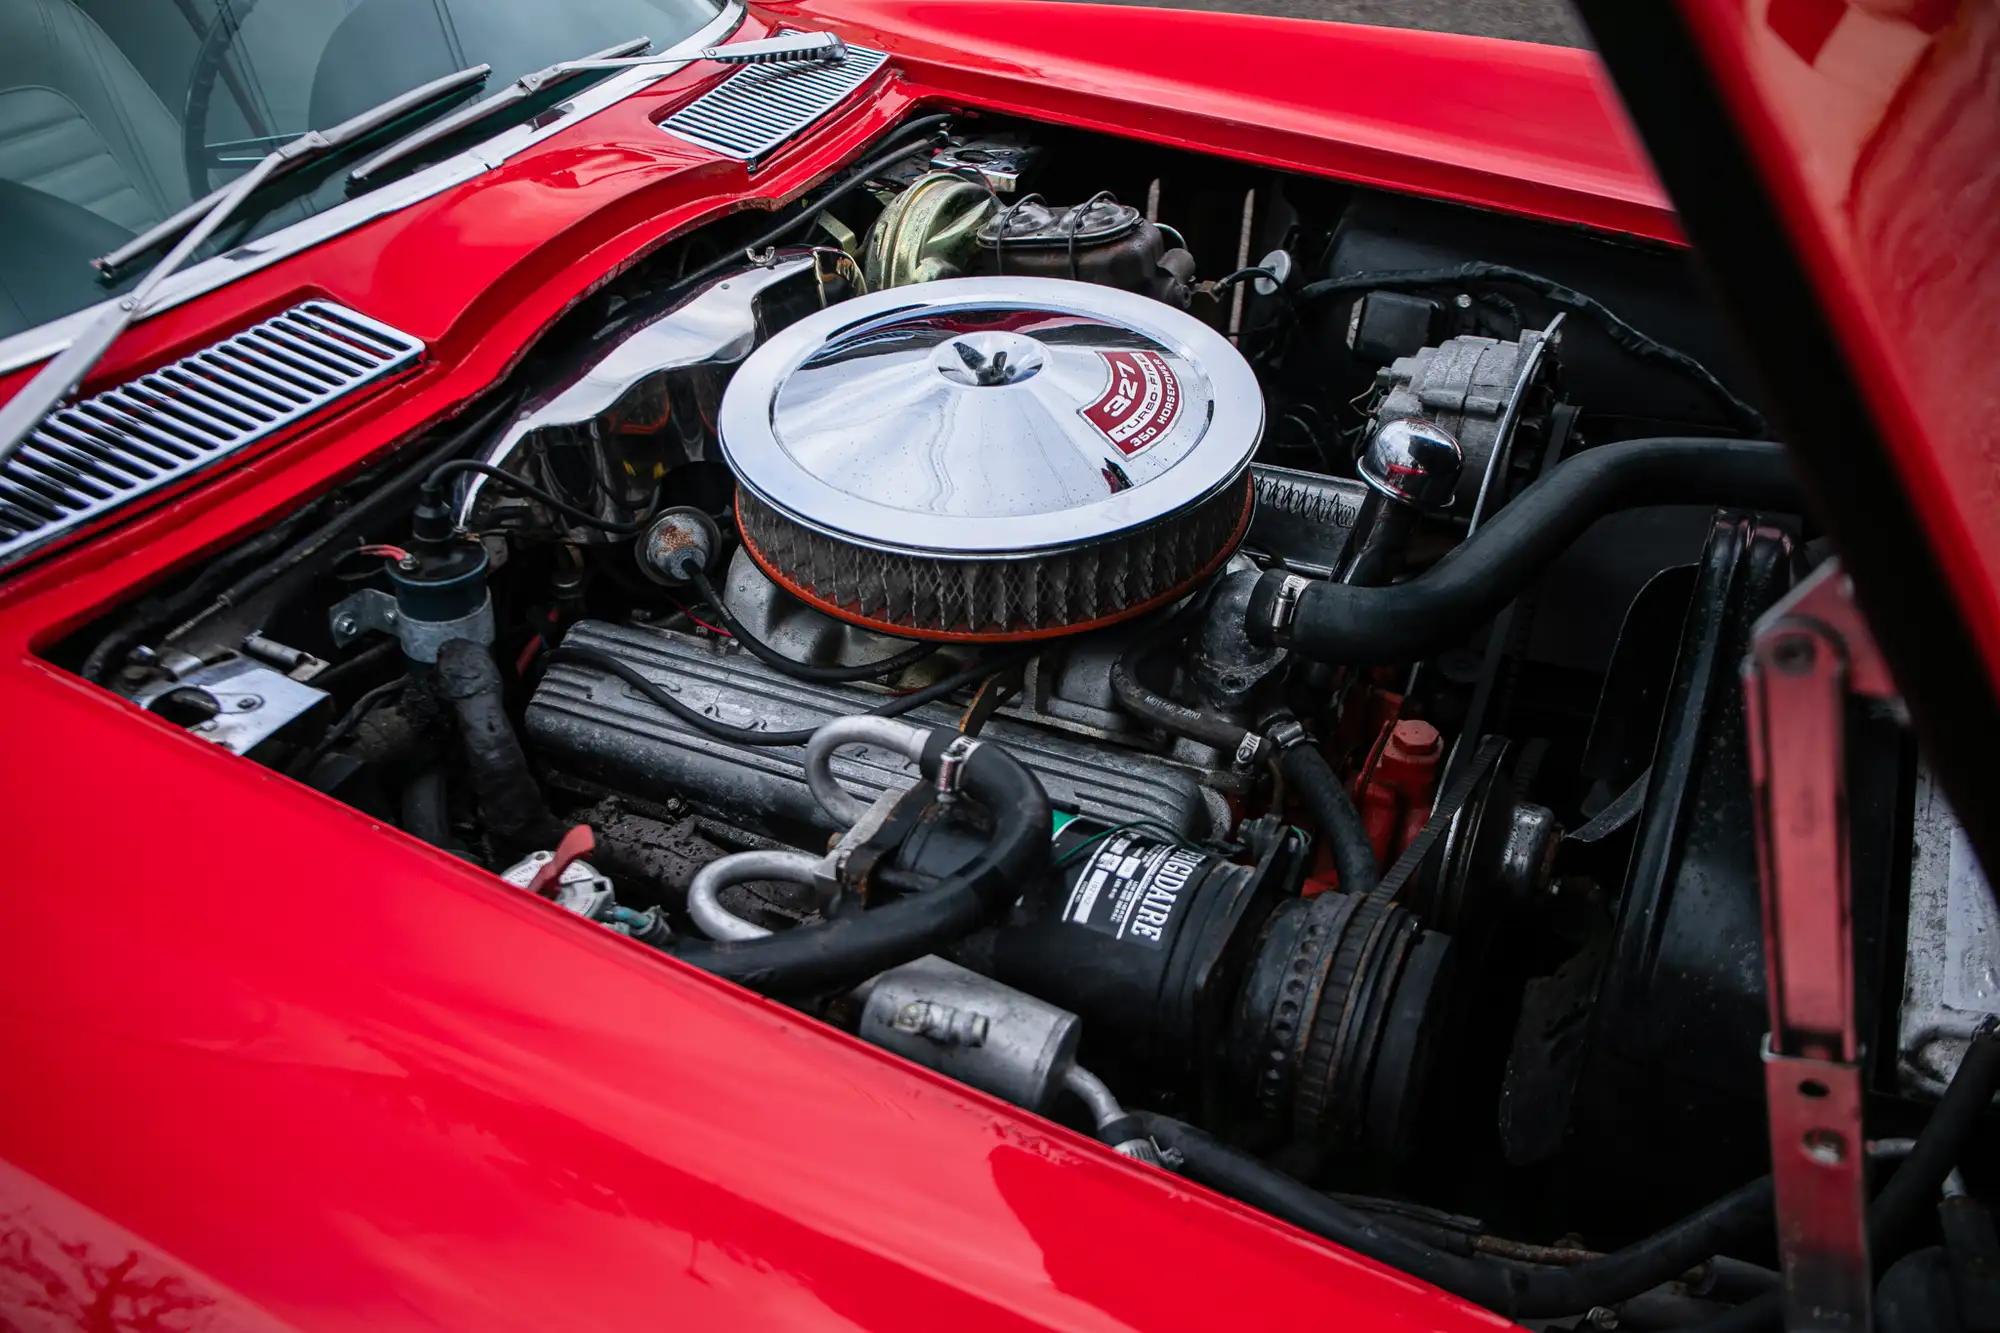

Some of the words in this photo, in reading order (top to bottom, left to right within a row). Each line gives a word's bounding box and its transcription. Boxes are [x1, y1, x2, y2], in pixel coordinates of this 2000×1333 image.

[1103, 361, 1138, 417] 327
[1116, 354, 1158, 435] TURBO-FIRE
[1130, 427, 1157, 447] 350
[1153, 358, 1176, 424] HORSEPOWER
[1130, 848, 1206, 941] FRIGIDAIRE
